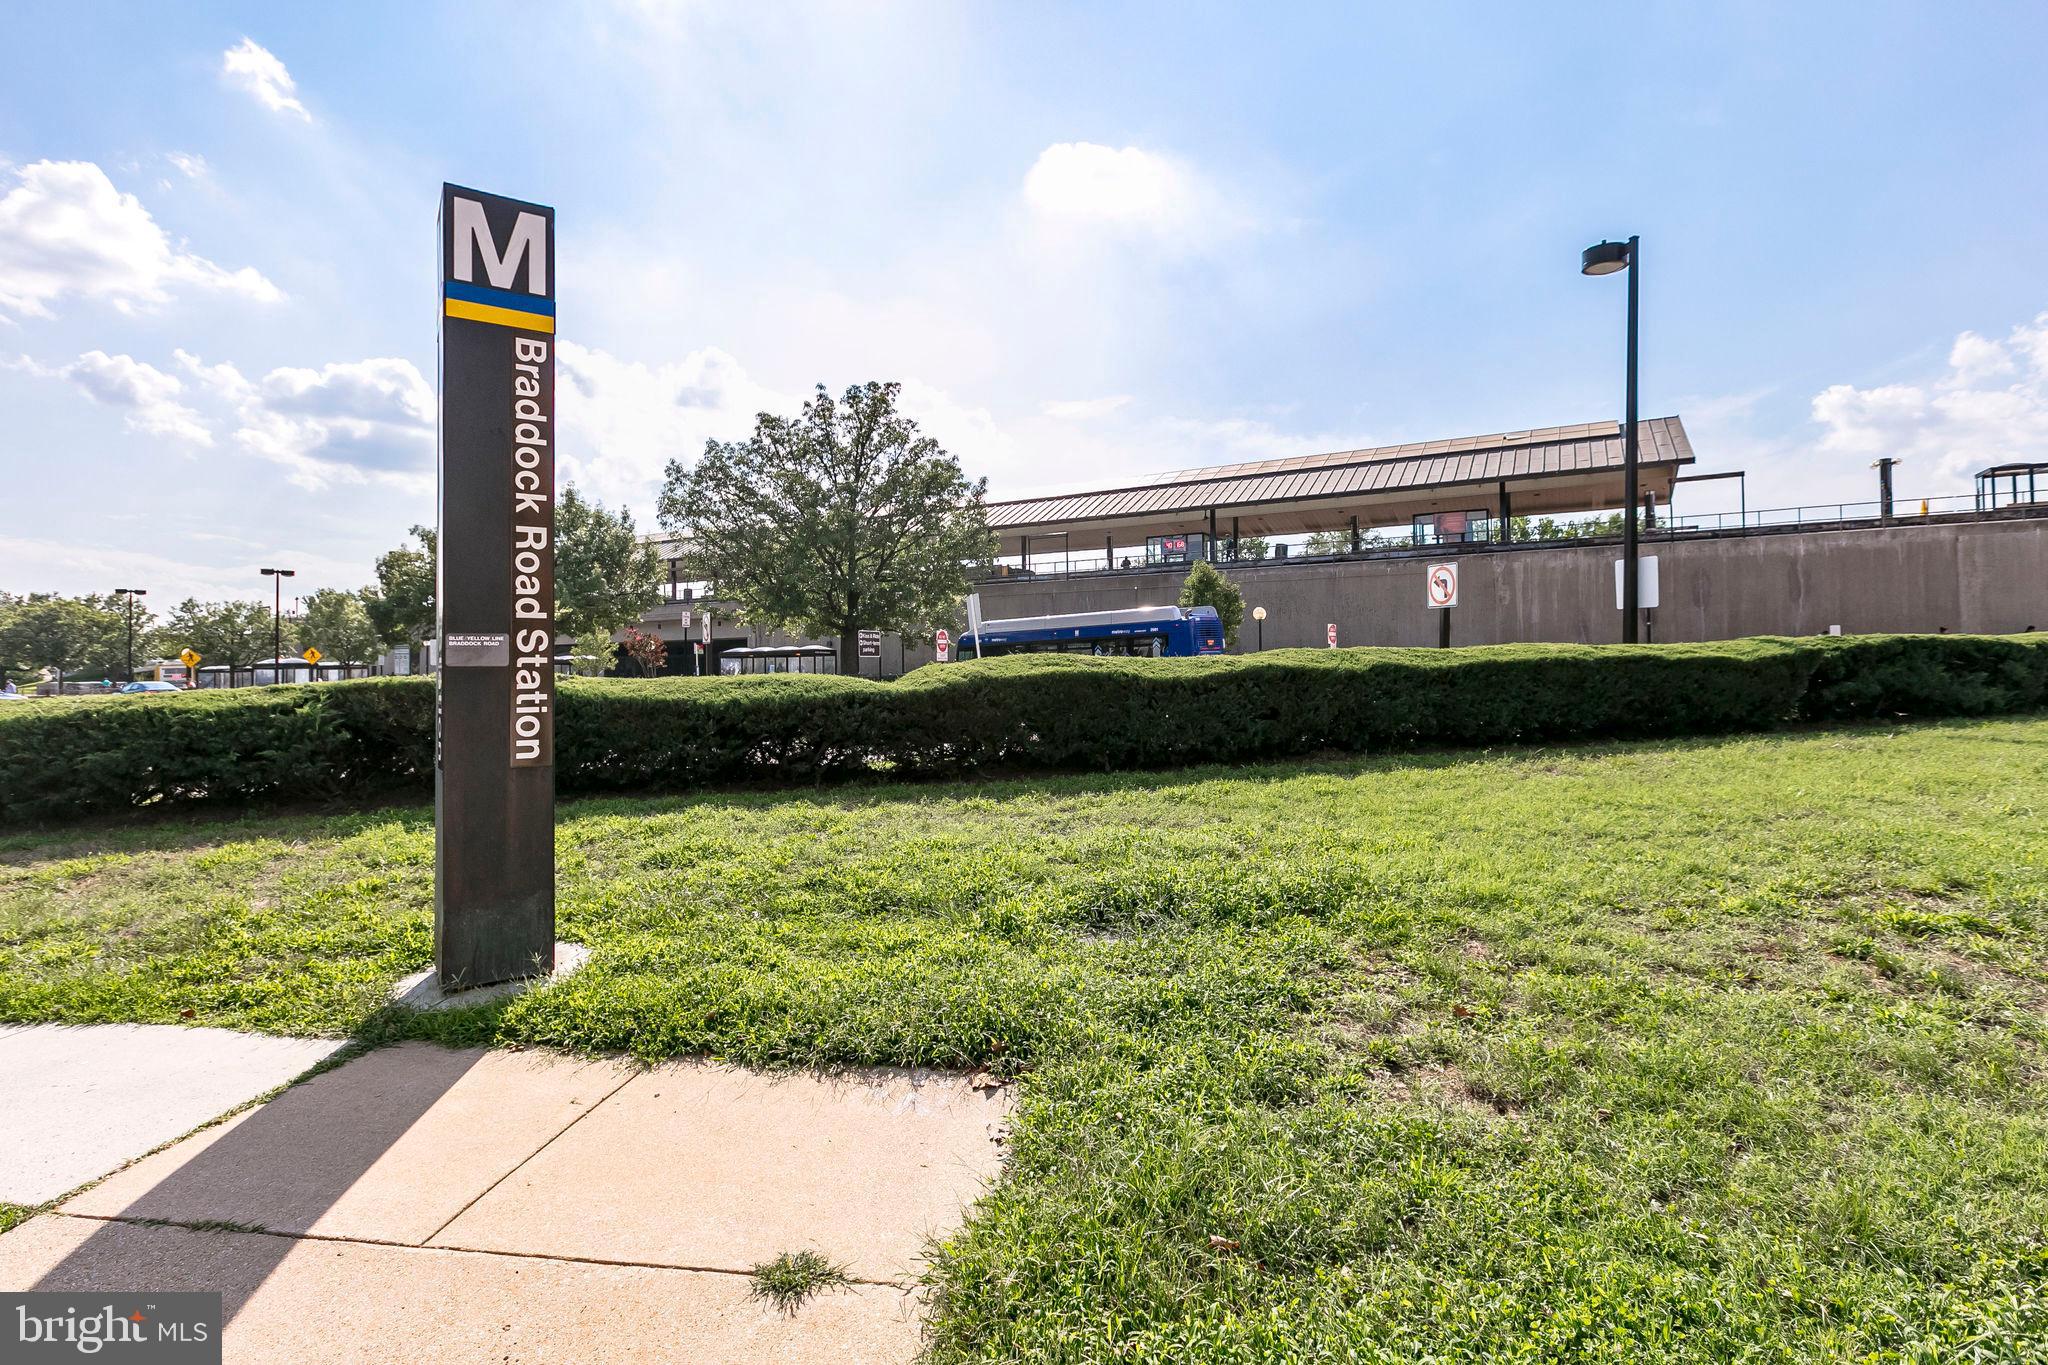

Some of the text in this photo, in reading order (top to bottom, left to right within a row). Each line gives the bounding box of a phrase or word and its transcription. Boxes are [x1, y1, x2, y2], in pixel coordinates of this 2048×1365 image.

[453, 195, 546, 296] M
[514, 336, 549, 760] Braddock Road Station
